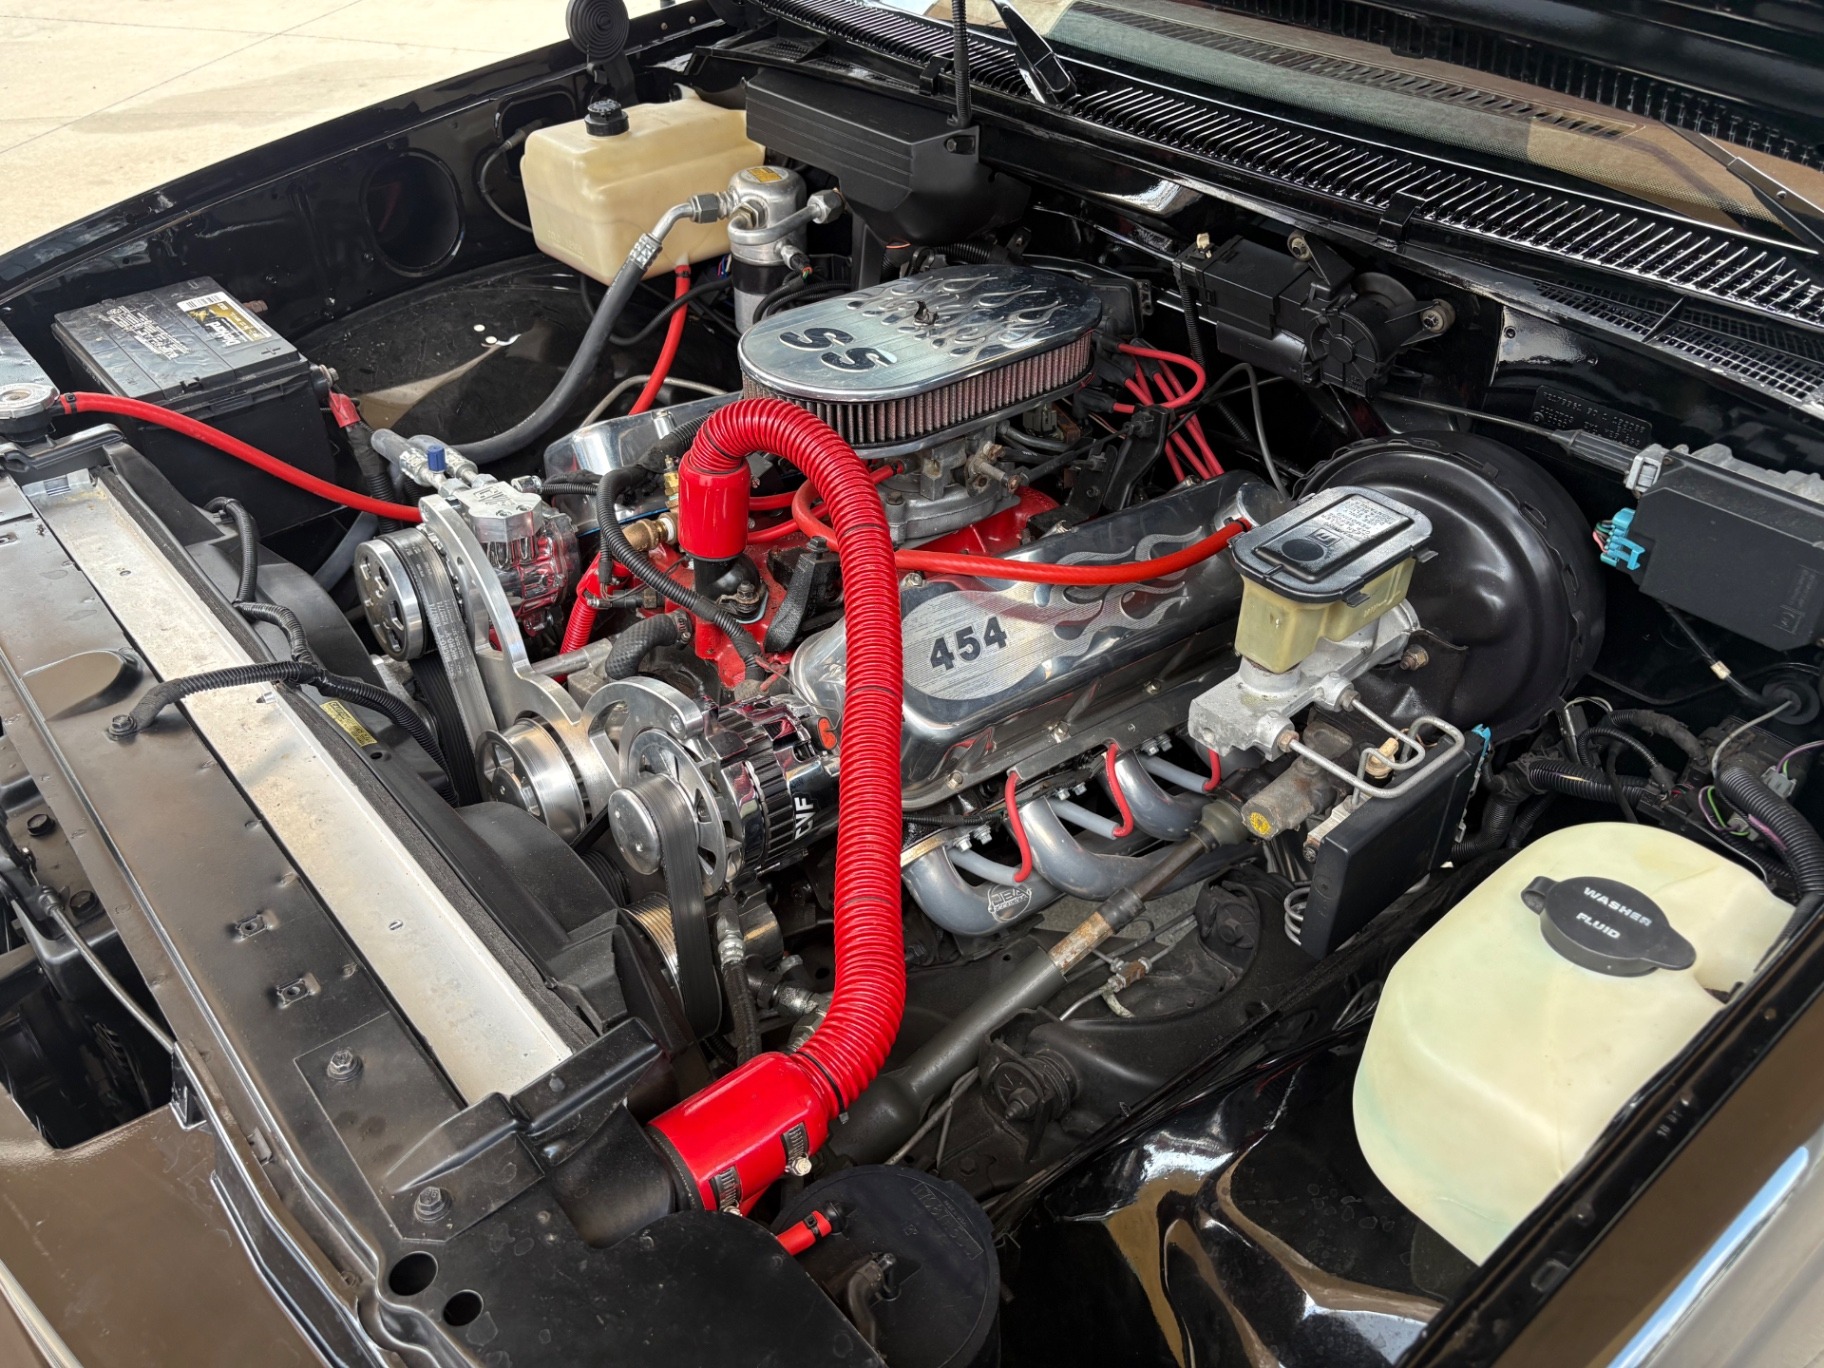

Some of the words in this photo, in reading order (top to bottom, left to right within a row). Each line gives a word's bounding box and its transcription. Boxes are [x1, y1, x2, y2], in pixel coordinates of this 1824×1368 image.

[779, 328, 897, 372] SS
[930, 616, 1007, 670] 454
[794, 797, 813, 841] CVF
[1576, 912, 1621, 939] FLUID
[1583, 887, 1652, 927] WASHER
